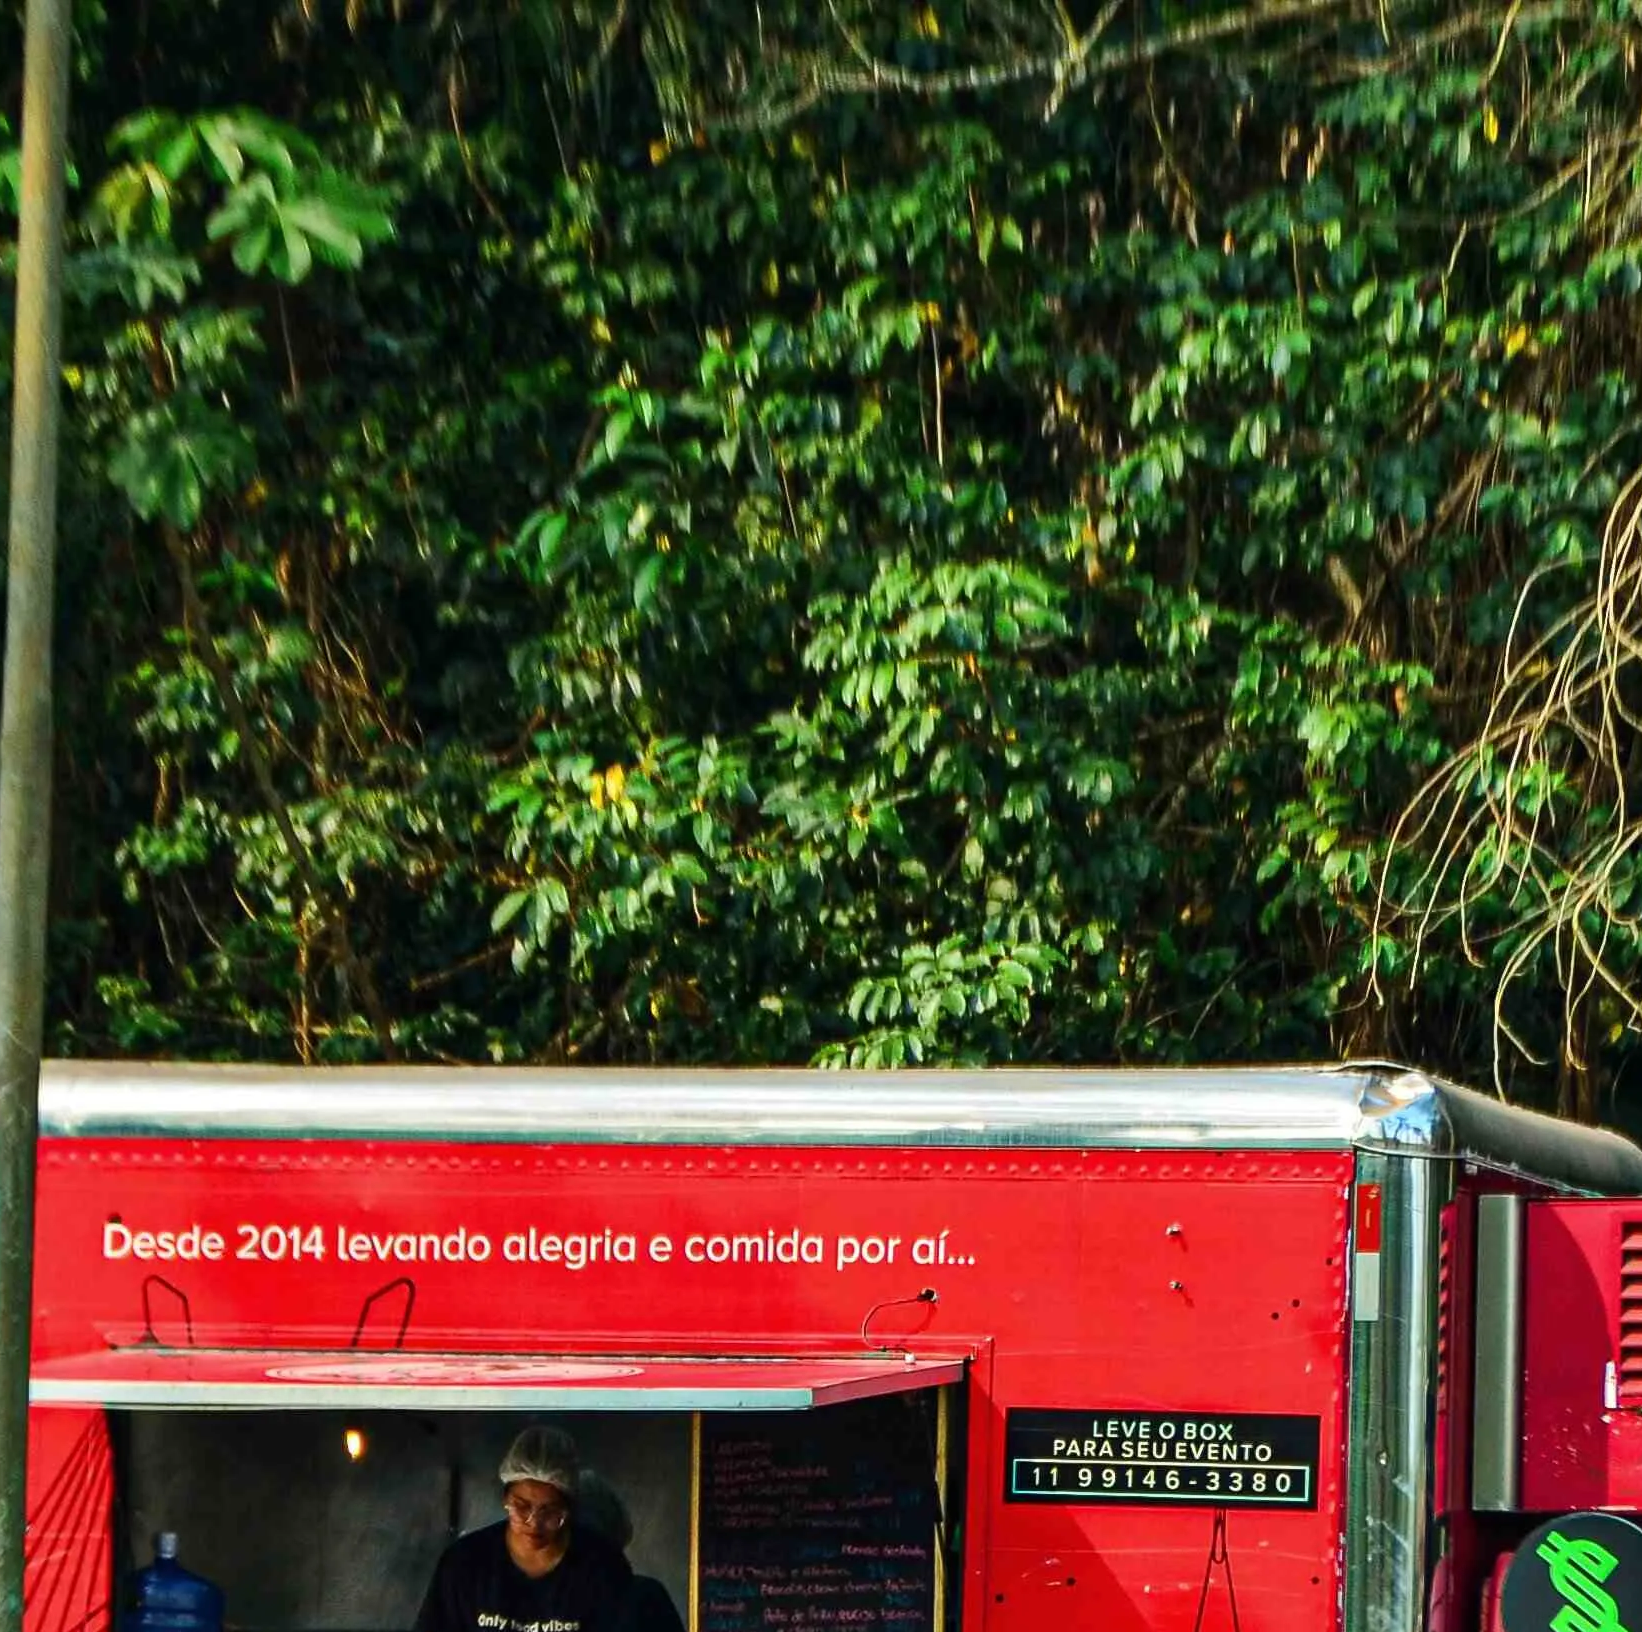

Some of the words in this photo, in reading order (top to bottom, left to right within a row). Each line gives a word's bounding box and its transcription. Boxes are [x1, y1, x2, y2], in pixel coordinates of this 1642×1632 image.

[102, 1223, 224, 1259] Desde
[236, 1226, 325, 1260] 2014
[337, 1226, 490, 1261] levando
[503, 1228, 636, 1269] alegria
[648, 1236, 672, 1263] e
[684, 1229, 822, 1264] comida
[836, 1236, 900, 1271] por
[911, 1231, 975, 1265] aí...
[1092, 1420, 1151, 1438] LEVE
[1158, 1422, 1176, 1440] O
[1183, 1423, 1234, 1441] BOX
[1053, 1440, 1114, 1457] PARA
[1121, 1441, 1167, 1459] SEU
[1175, 1443, 1273, 1462] EVENTO
[1032, 1467, 1058, 1487] 11
[1078, 1468, 1291, 1493] 99146-3380
[477, 1613, 507, 1630] Only
